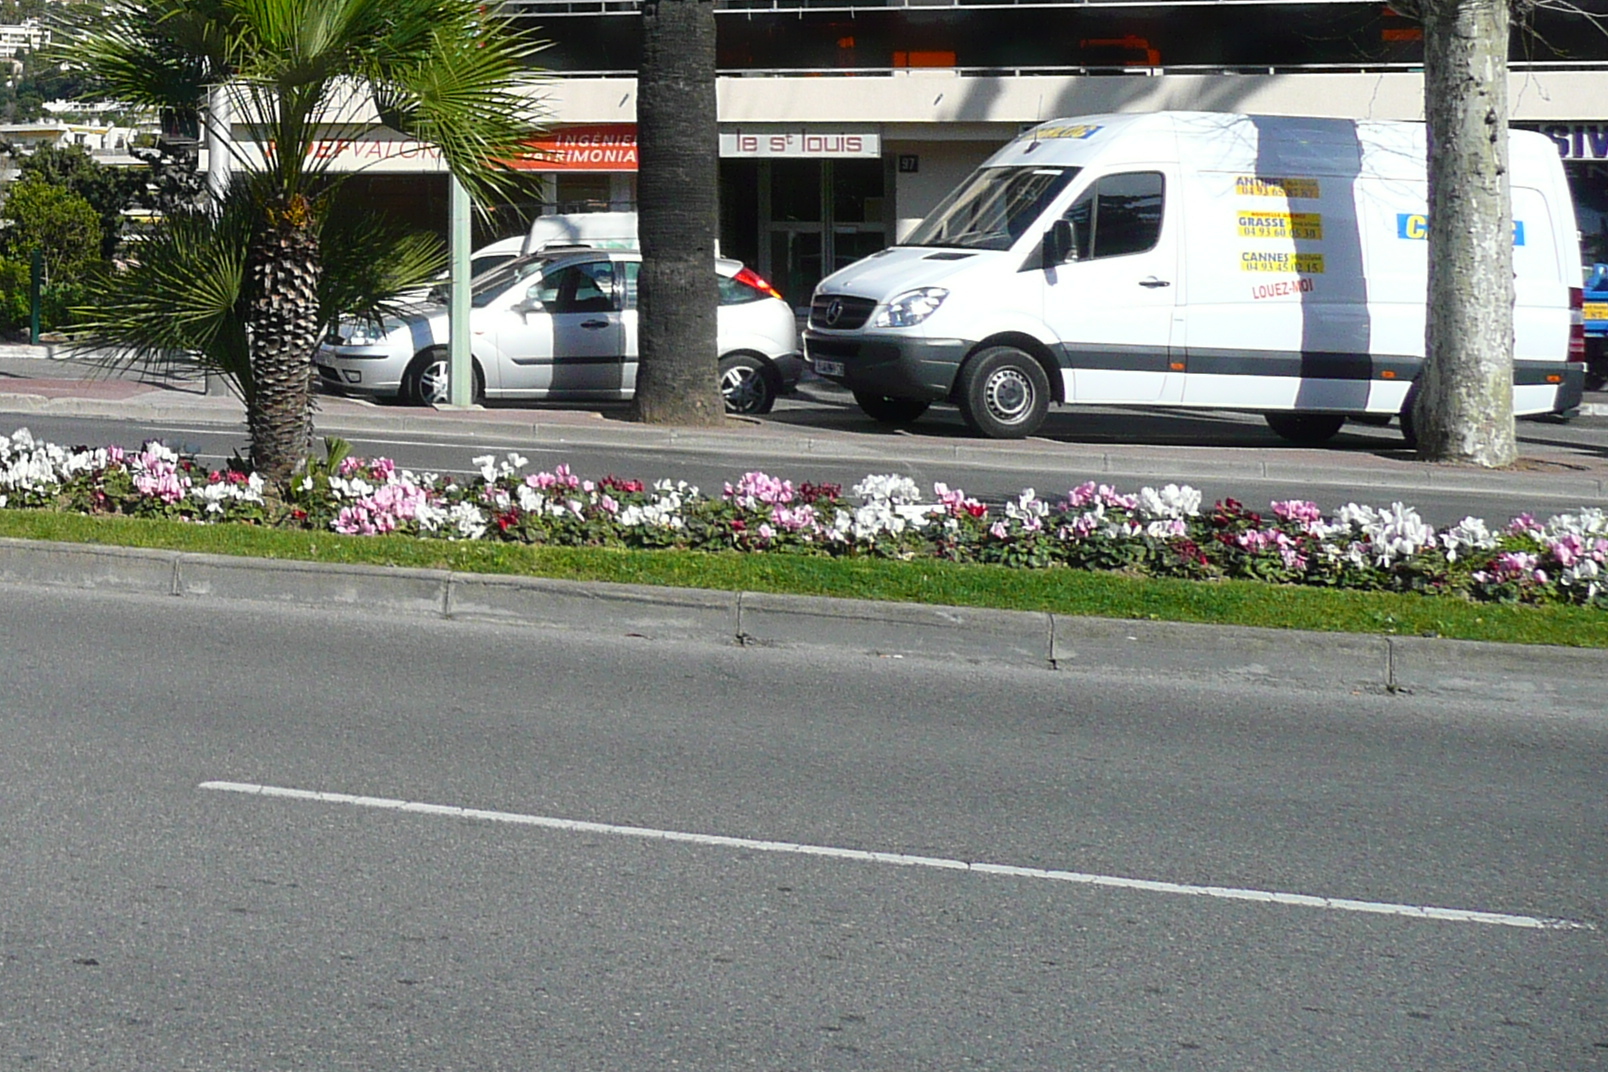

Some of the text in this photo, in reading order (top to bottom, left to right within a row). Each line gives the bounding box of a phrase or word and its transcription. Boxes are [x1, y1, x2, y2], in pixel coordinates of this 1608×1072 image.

[555, 132, 637, 147] INGÉNIE
[737, 128, 758, 152] le
[802, 128, 862, 152] louis
[901, 158, 914, 170] 97
[1239, 217, 1285, 227] GRASSE
[1242, 252, 1288, 262] CANNES
[1252, 278, 1314, 299] LOUEZ-MOI
